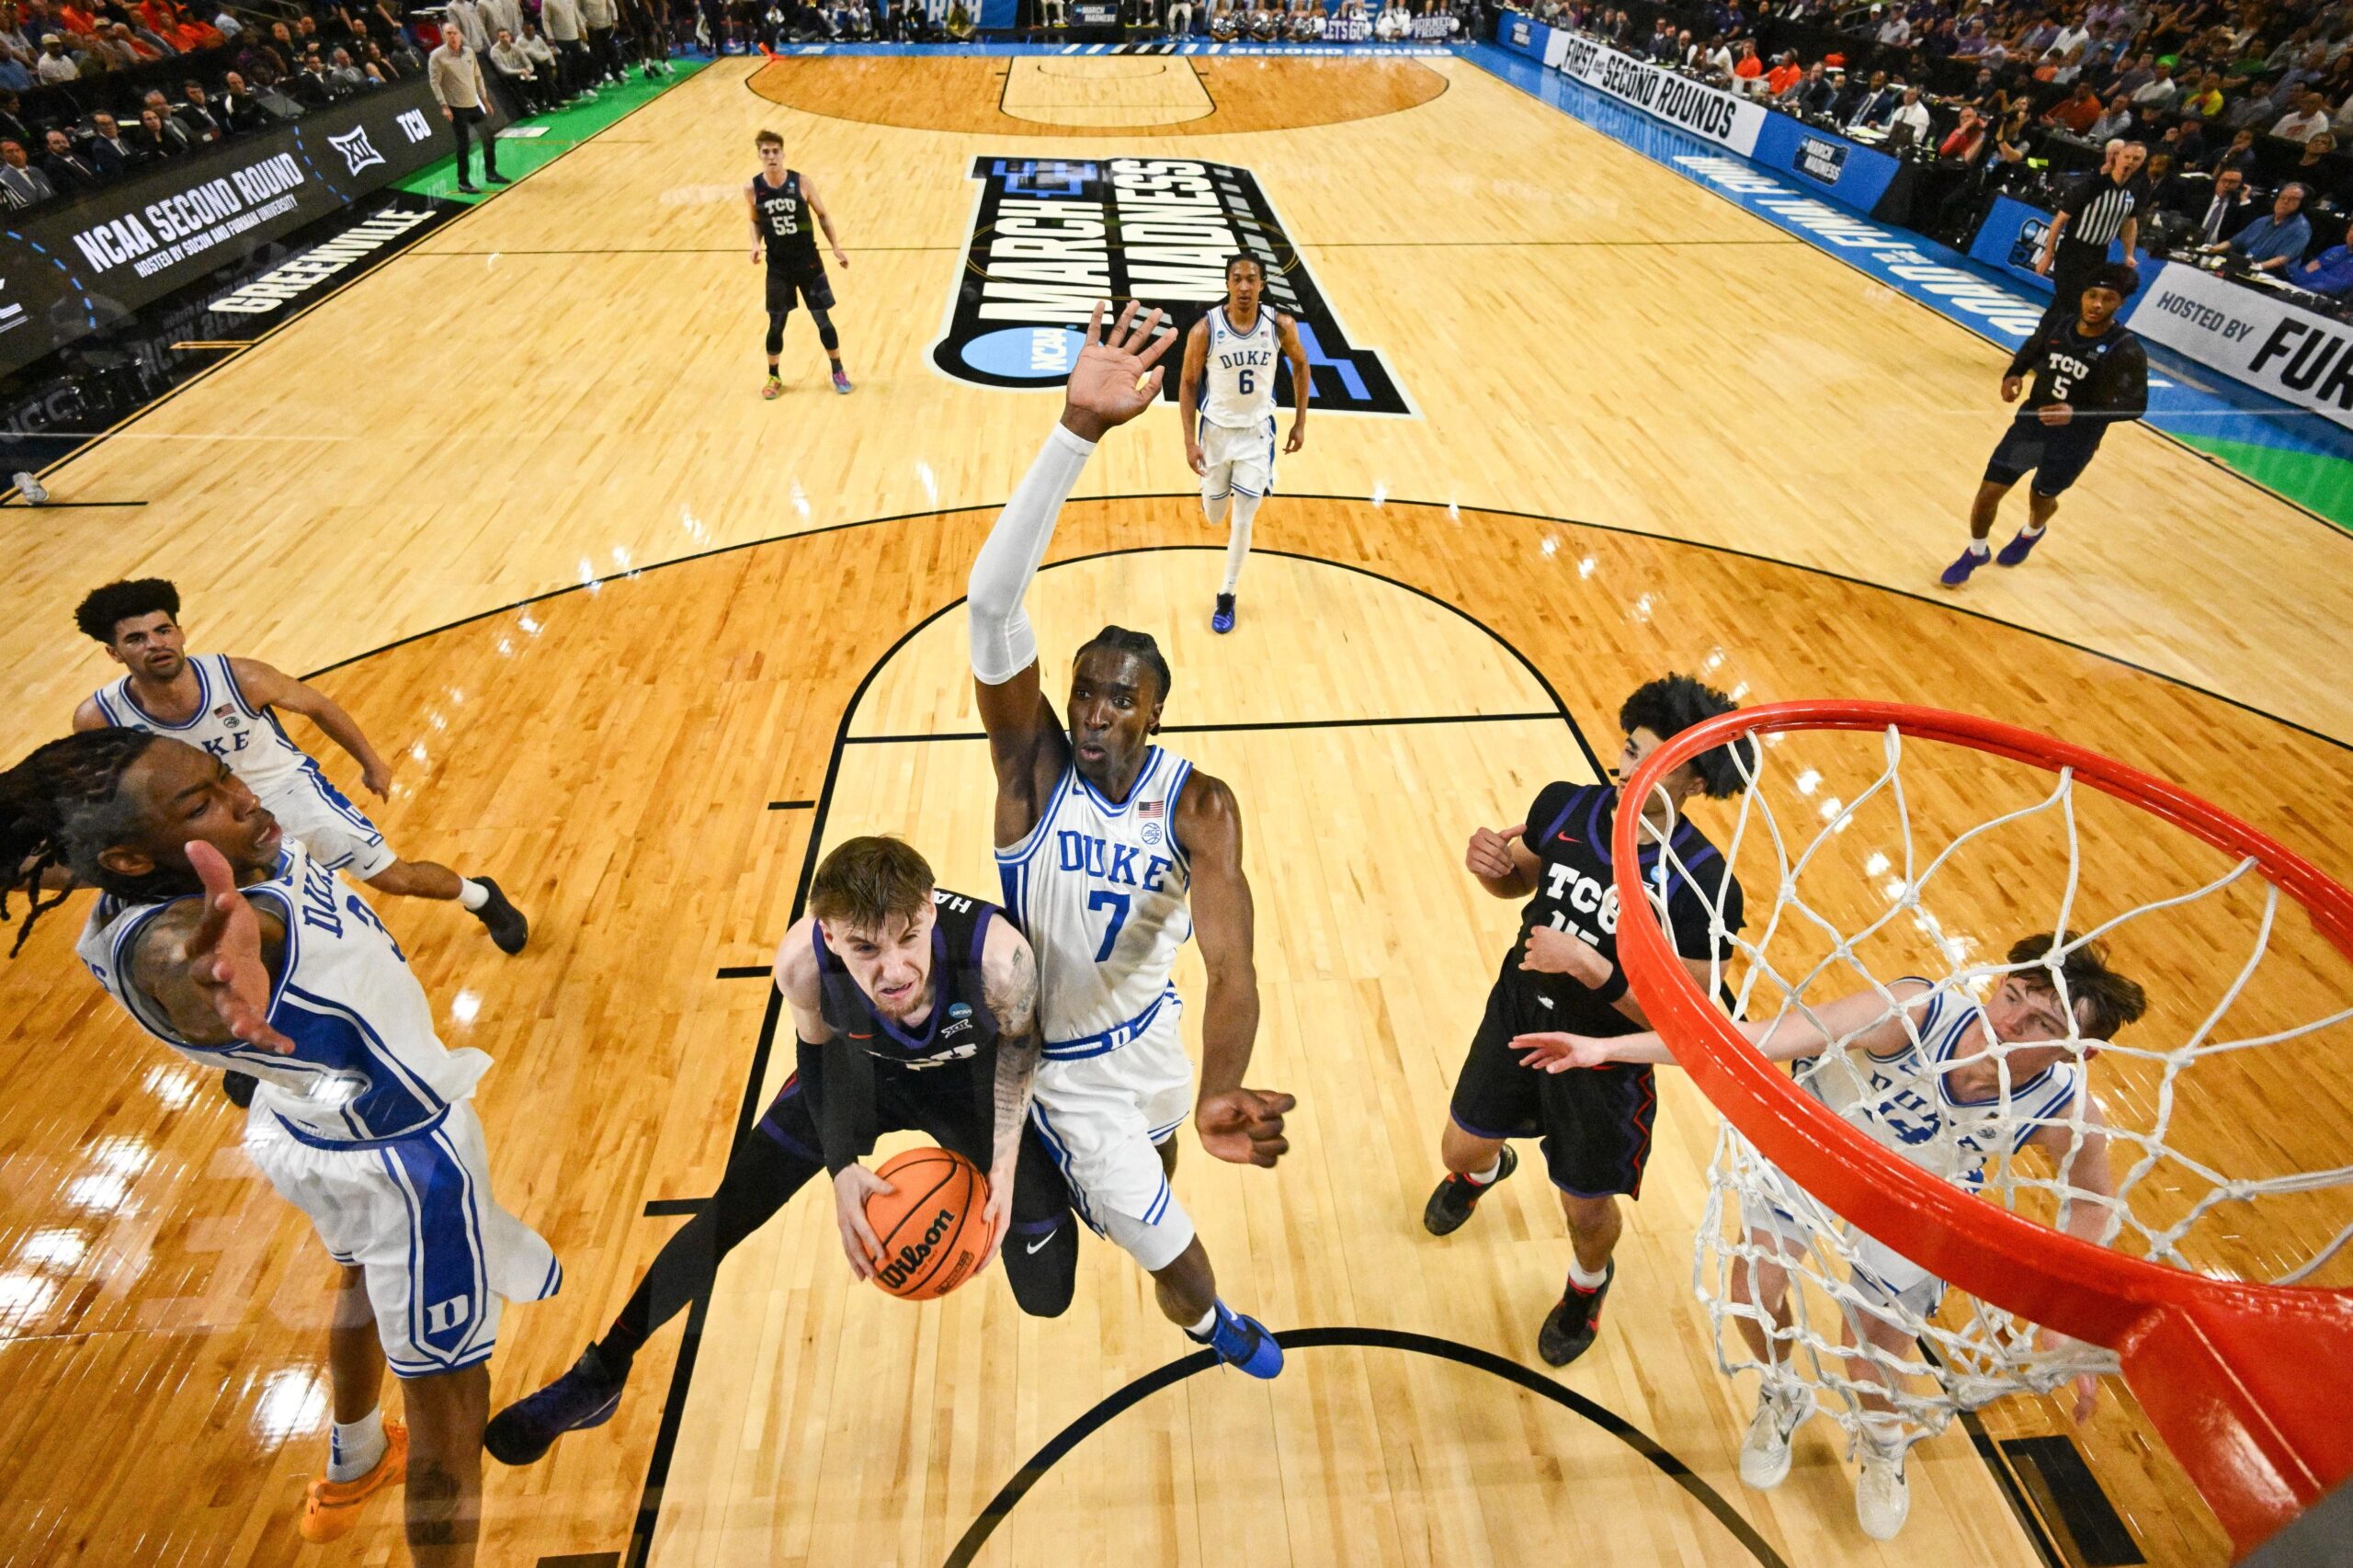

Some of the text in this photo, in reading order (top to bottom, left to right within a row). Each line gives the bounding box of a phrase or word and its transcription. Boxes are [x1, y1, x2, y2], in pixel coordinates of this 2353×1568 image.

[1563, 38, 1599, 79] FIRST
[1602, 55, 1660, 107] SECOND
[1654, 77, 1737, 140] ROUNDS
[396, 108, 432, 143] TCU
[1804, 153, 1842, 181] MADNESS
[1806, 139, 1836, 161] MARCH
[74, 152, 305, 274] NCAA SECOND ROUND
[765, 198, 797, 215] TCU
[772, 215, 798, 236] 55
[133, 246, 173, 278] HOSTED
[168, 243, 187, 262] BY
[210, 222, 231, 244] AND
[1110, 159, 1242, 302] MADNESS
[208, 210, 438, 313] GREENVILLE
[978, 199, 1115, 324] MARCH
[2157, 290, 2226, 333] HOSTED
[2222, 318, 2255, 343] BY
[1030, 328, 1068, 371] NCAA
[1219, 350, 1272, 369] DUKE
[2049, 352, 2089, 381] TCU
[1239, 369, 1255, 395] 6
[2052, 375, 2072, 401] 5
[201, 729, 250, 756] KE
[1057, 830, 1173, 892] DUKE
[1088, 890, 1131, 963] 7
[1108, 1026, 1131, 1050] D
[878, 1209, 955, 1290] Wilson
[426, 1294, 470, 1335] D
